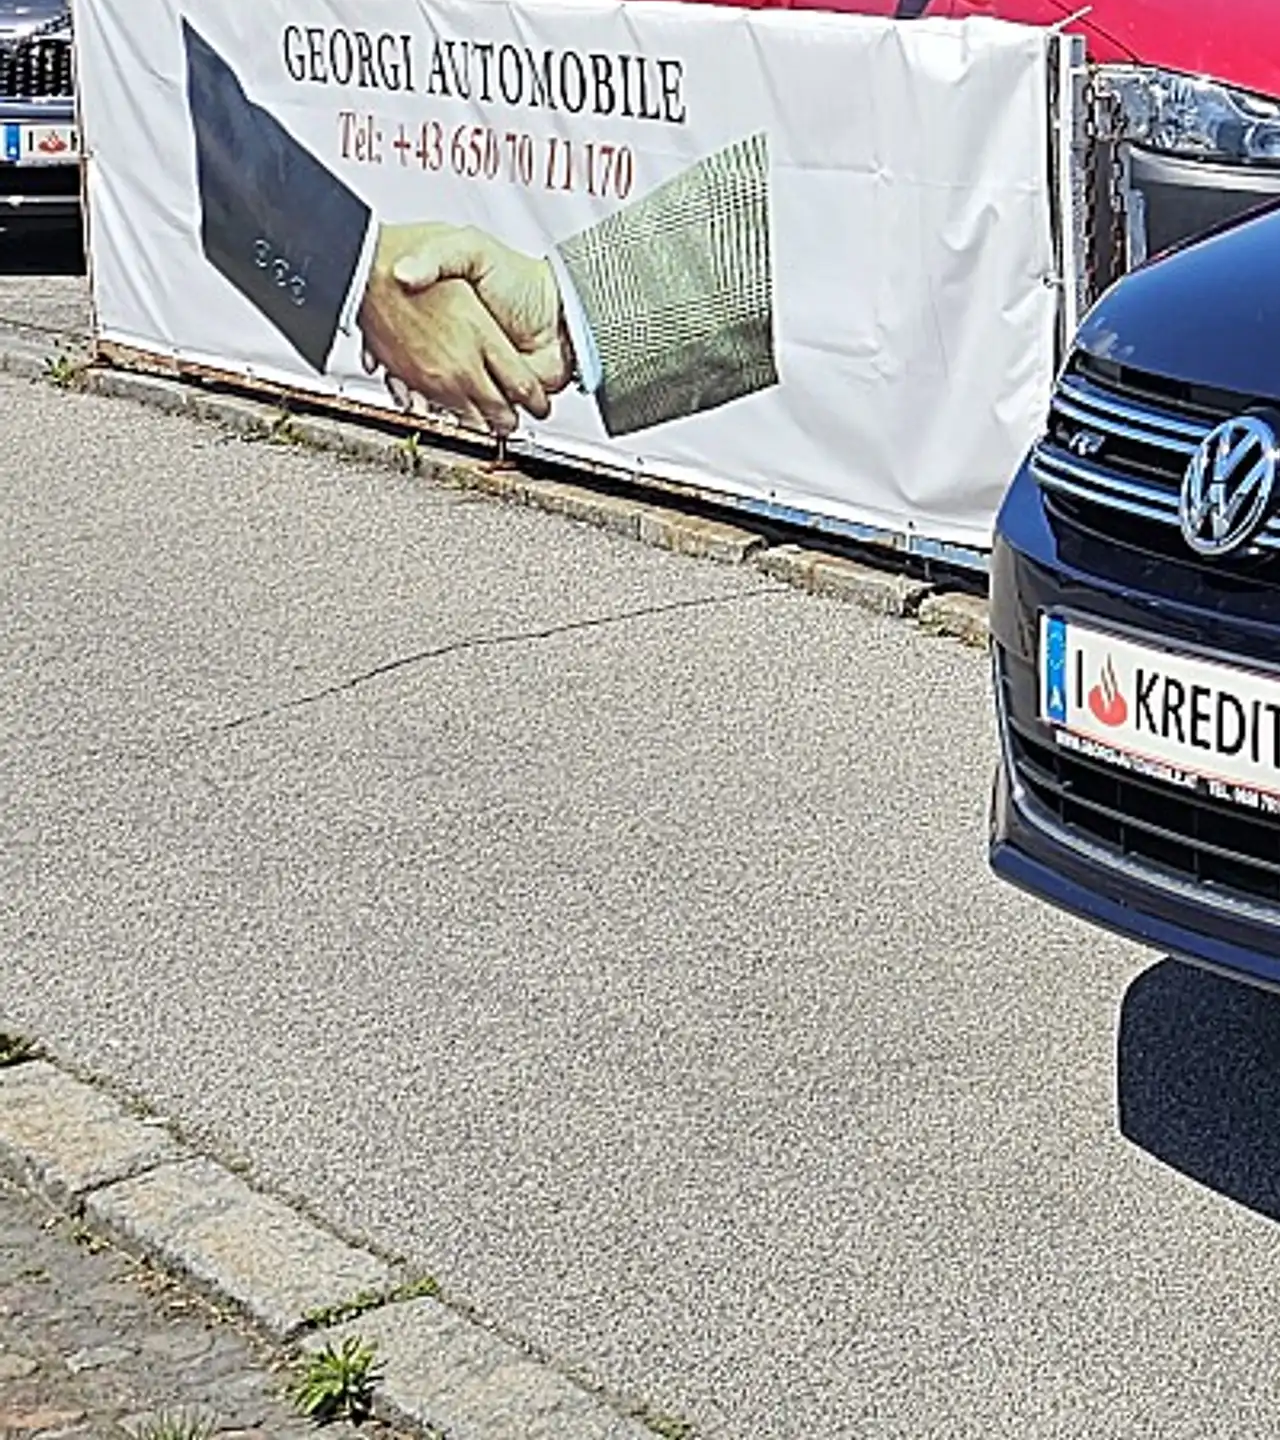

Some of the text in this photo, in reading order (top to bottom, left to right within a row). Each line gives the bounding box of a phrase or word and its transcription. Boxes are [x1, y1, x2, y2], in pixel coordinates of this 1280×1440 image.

[283, 25, 687, 124] GEORGI AUTOMOBILE
[340, 112, 633, 199] Tel: +43 650 70 11 170
